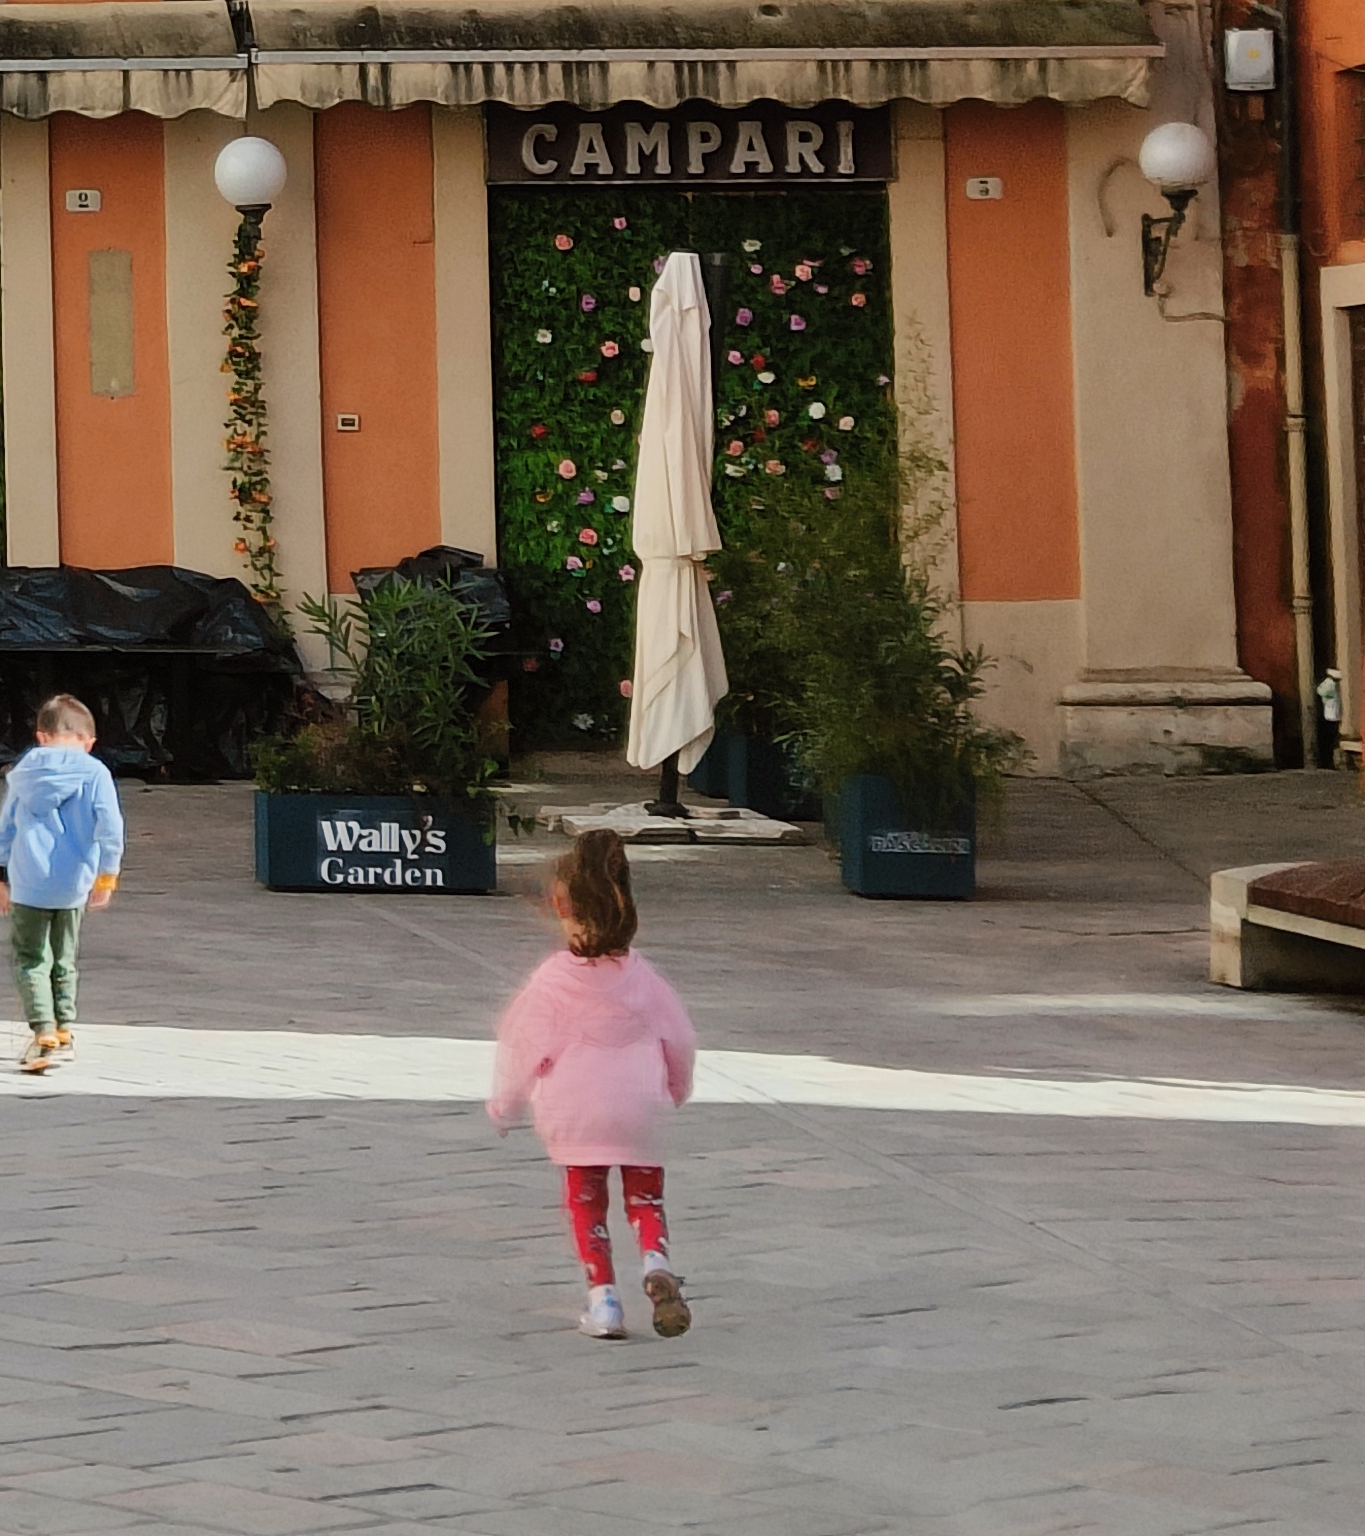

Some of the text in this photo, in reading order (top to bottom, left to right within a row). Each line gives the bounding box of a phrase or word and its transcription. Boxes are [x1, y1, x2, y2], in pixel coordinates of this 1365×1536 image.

[521, 120, 855, 175] CAMPARI
[320, 815, 447, 860] Wally's
[320, 857, 445, 887] Garden
